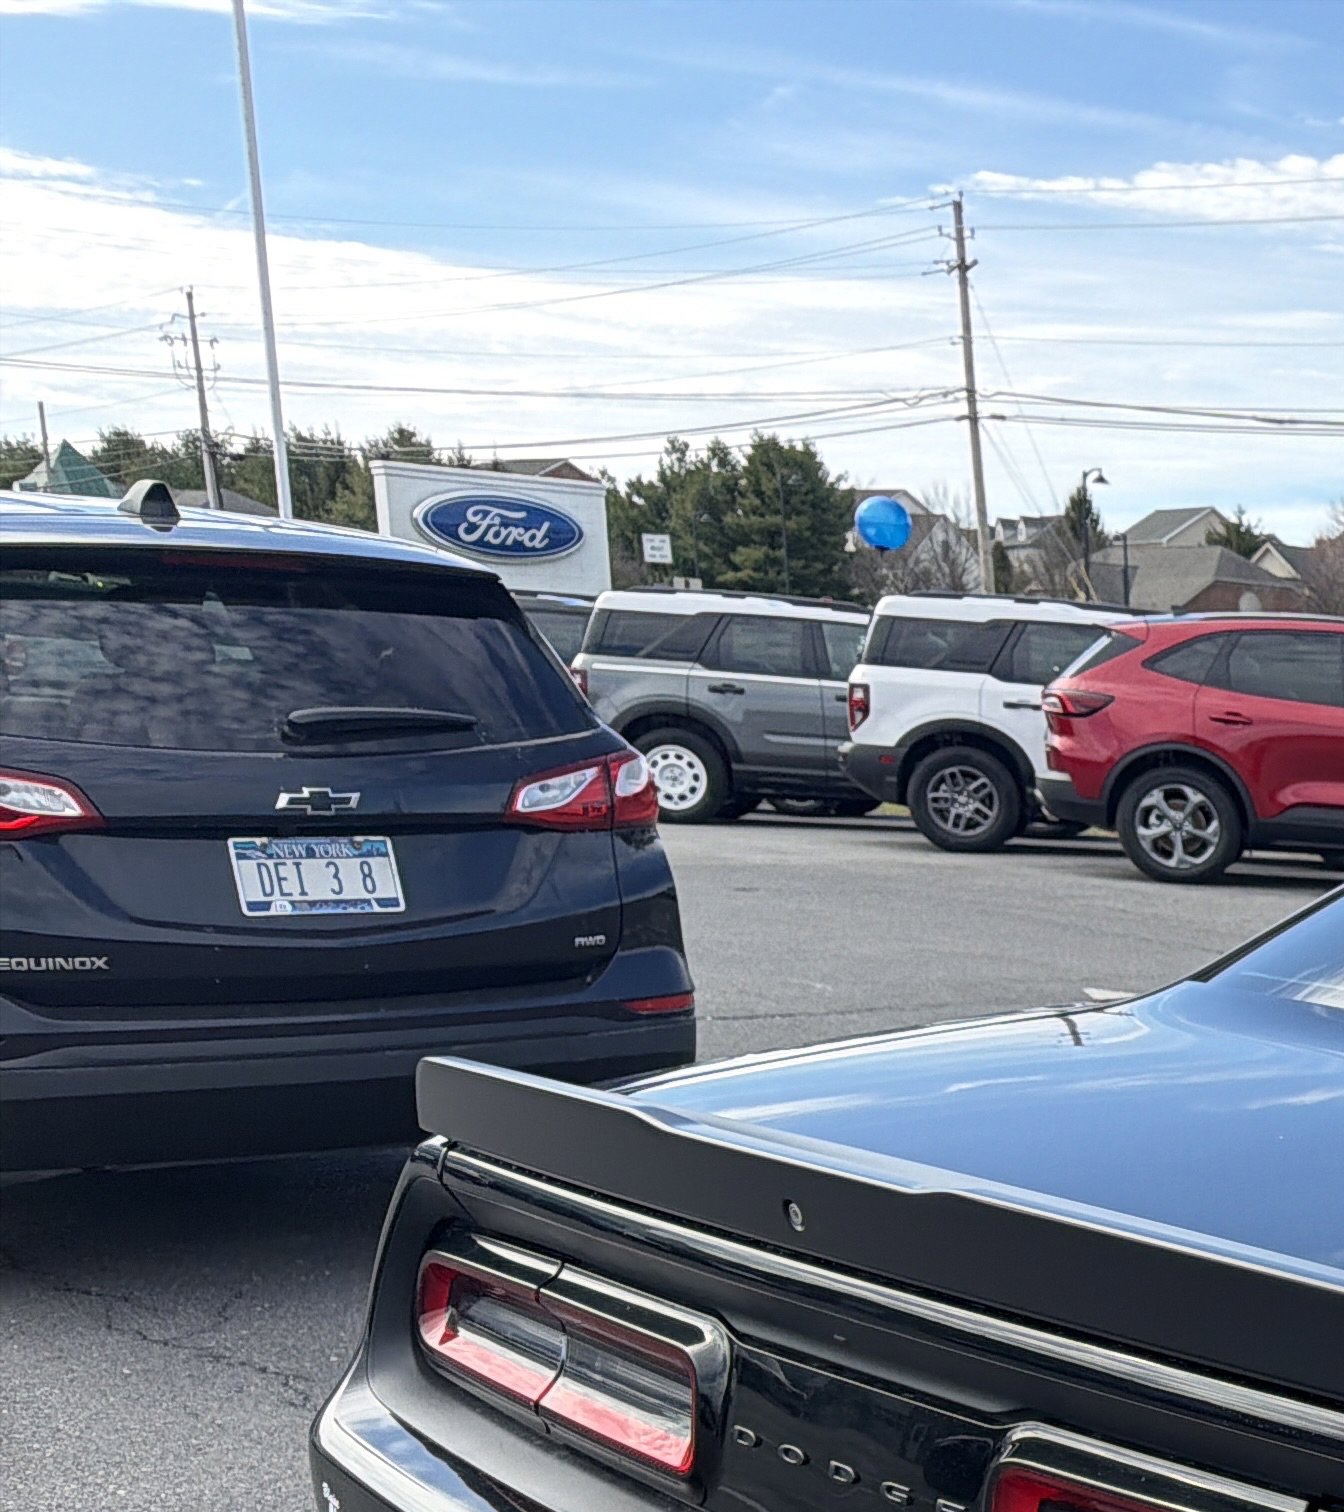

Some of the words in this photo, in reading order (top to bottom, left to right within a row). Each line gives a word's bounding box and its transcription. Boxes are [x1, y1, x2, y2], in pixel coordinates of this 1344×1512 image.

[458, 504, 549, 549] Ford
[272, 843, 308, 858] NEW
[311, 842, 354, 858] YORK
[0, 957, 110, 971] EQUINOX
